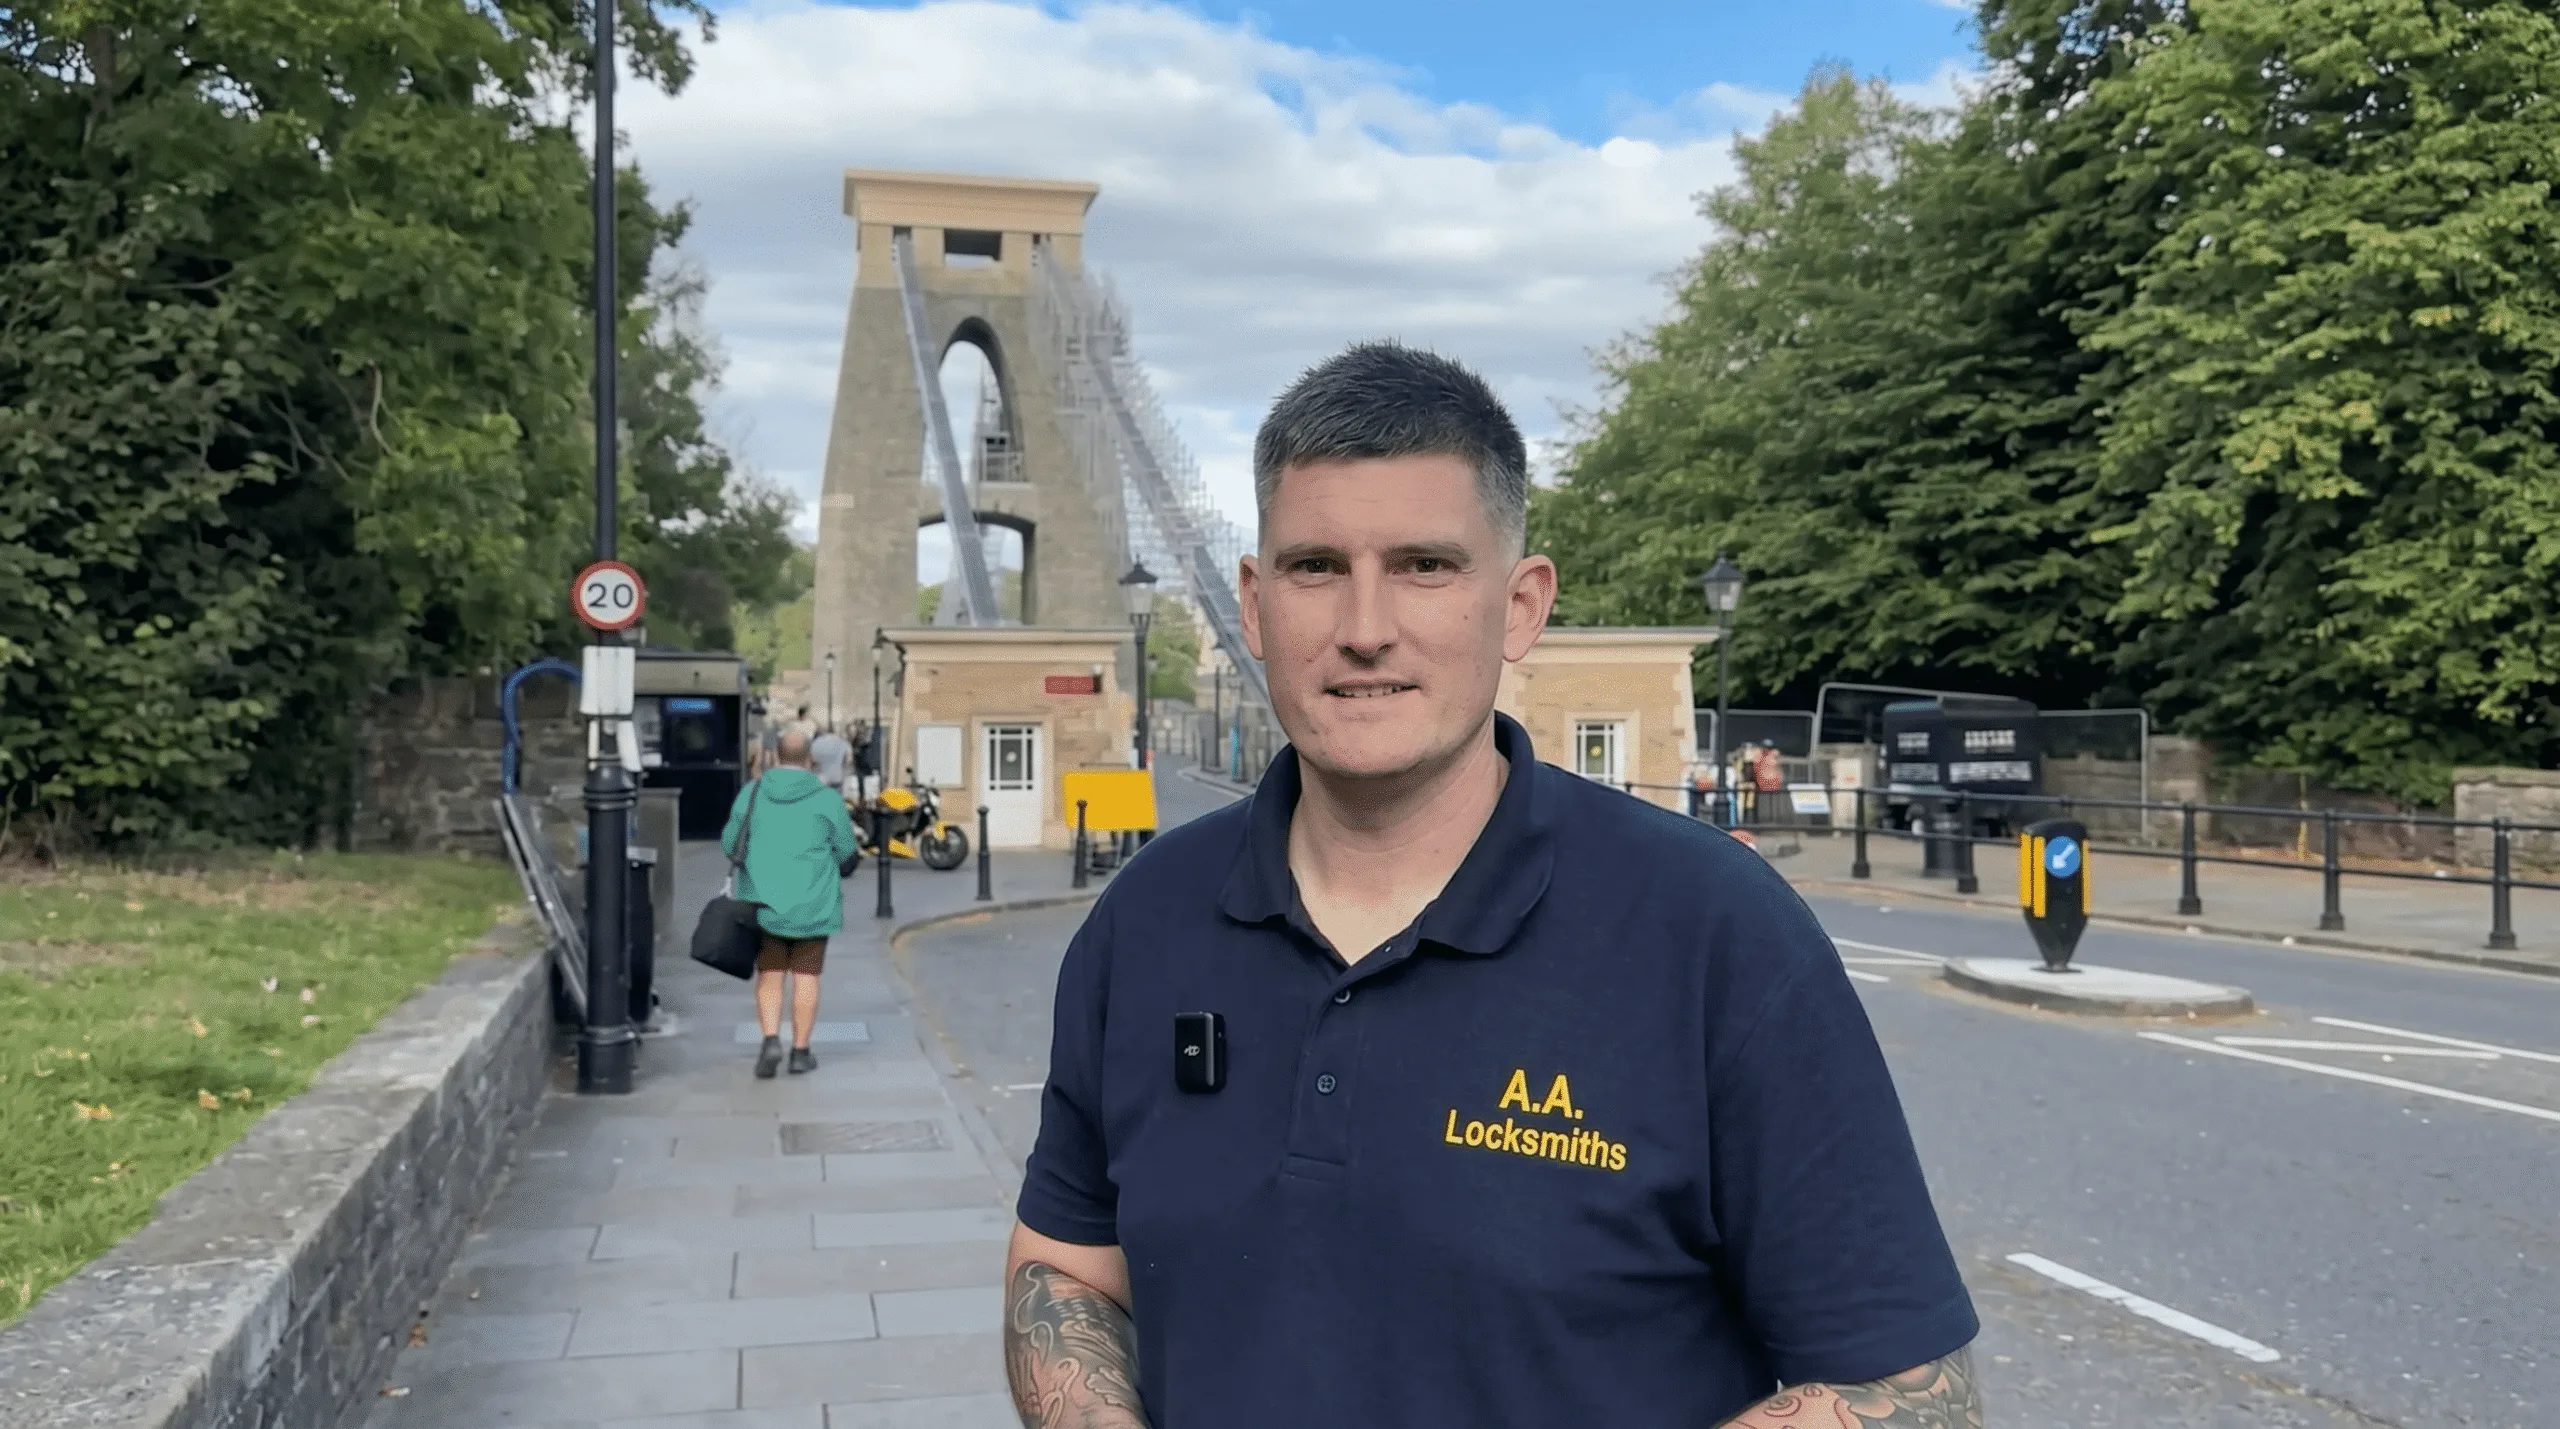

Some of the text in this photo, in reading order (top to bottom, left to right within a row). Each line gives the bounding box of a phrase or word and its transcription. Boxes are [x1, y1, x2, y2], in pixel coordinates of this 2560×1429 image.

[587, 582, 634, 609] 20
[1499, 1069, 1583, 1120] A.A.
[1445, 1109, 1627, 1171] Locksmiths
